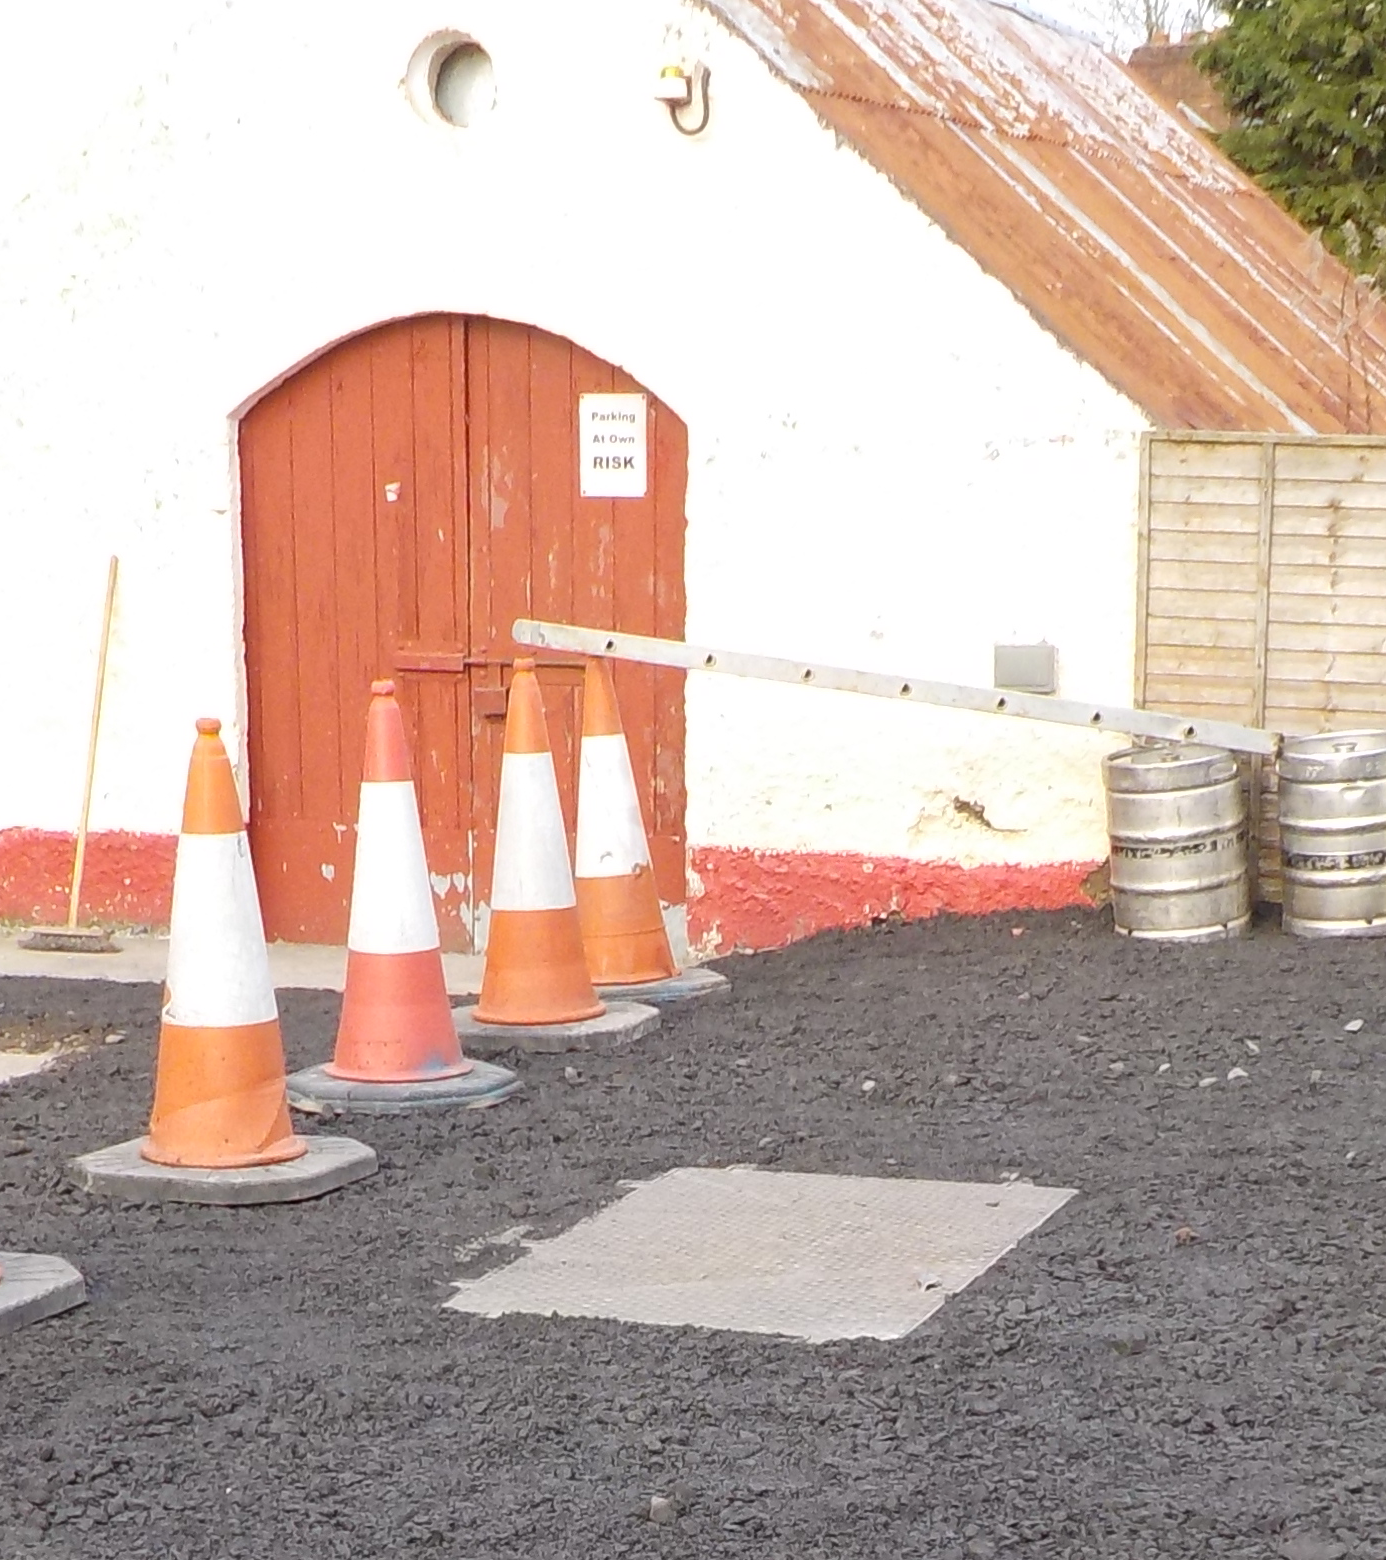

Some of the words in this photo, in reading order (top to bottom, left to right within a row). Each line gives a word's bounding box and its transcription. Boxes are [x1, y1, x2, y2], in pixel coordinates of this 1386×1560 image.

[591, 411, 636, 423] Parking
[592, 434, 605, 444] At
[609, 434, 635, 444] Own
[593, 456, 635, 470] RISK
